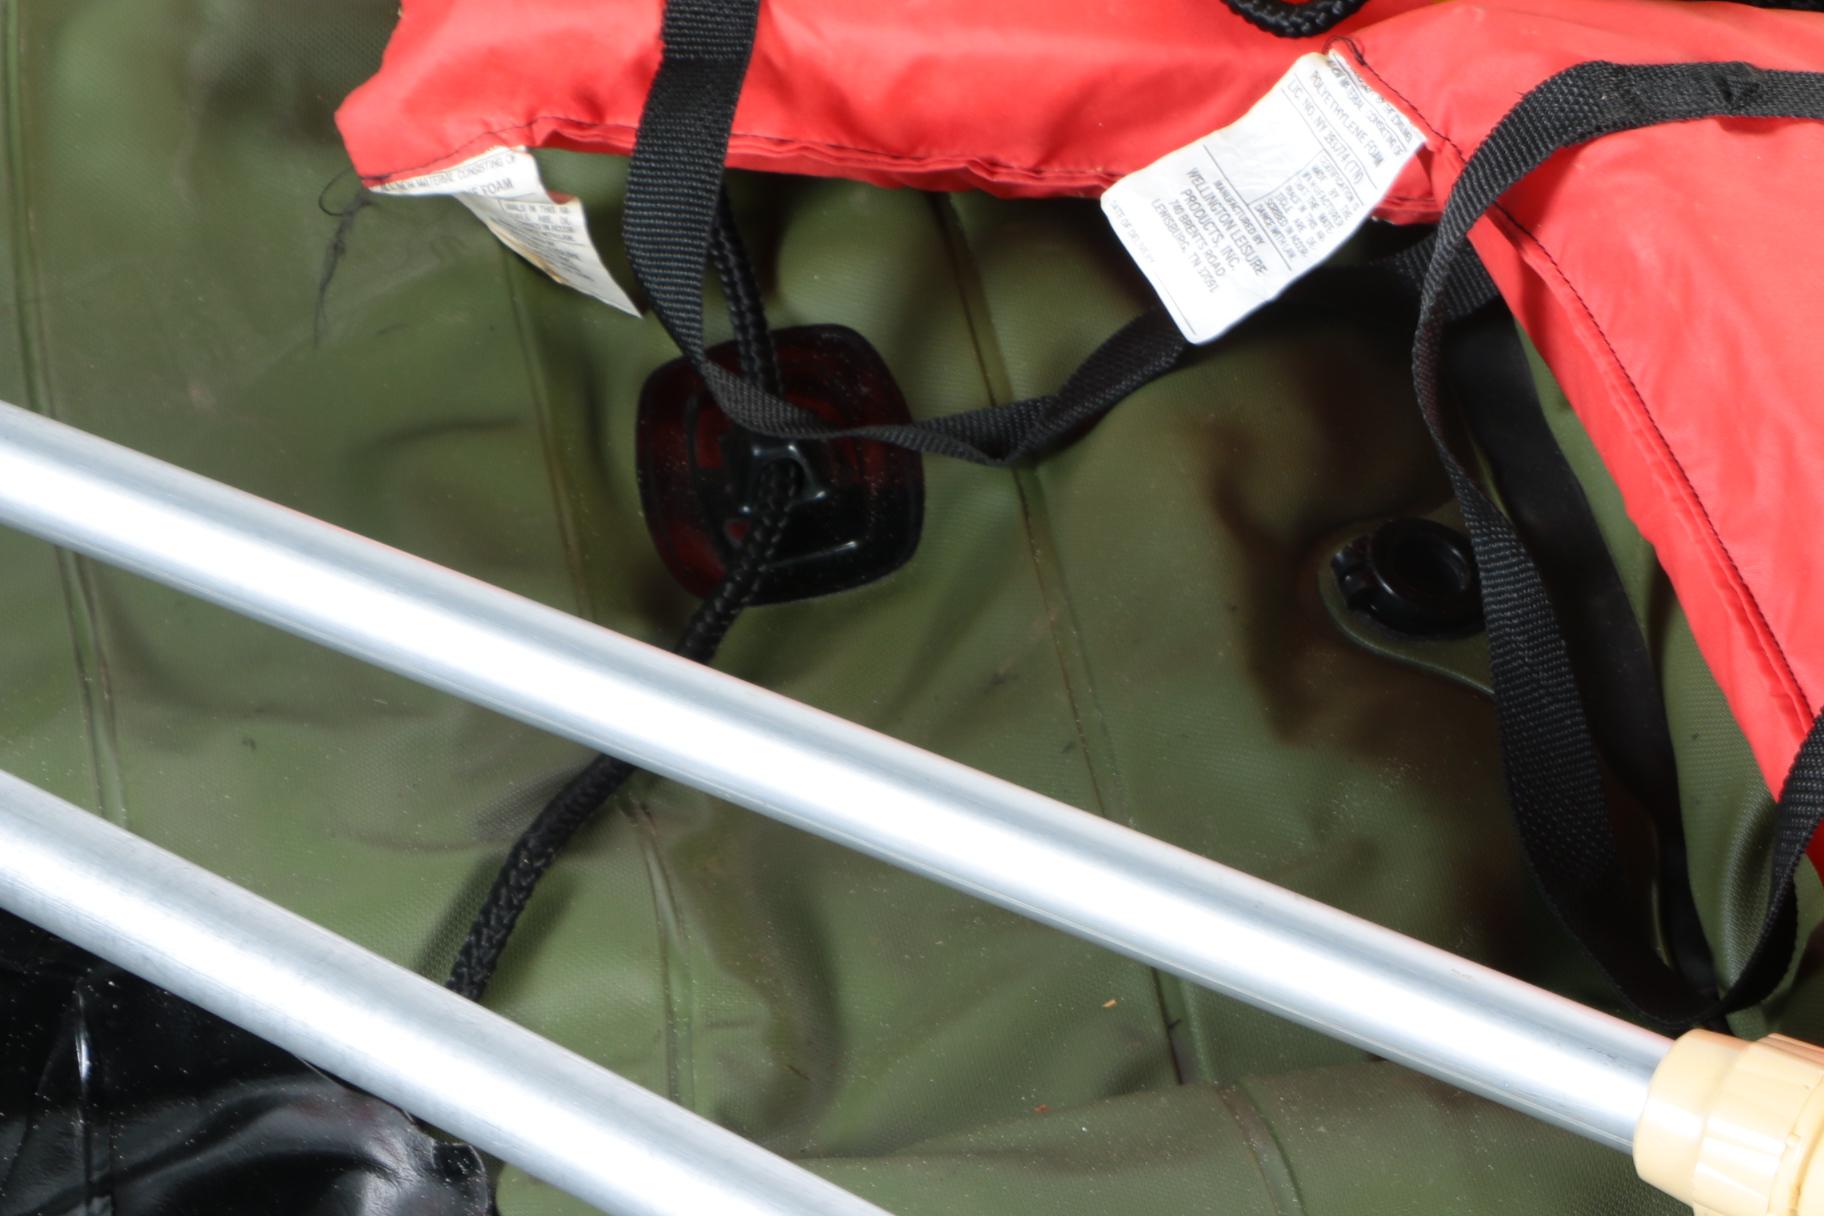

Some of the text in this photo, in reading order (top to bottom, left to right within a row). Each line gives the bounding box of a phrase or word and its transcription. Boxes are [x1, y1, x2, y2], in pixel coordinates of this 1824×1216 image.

[1365, 139, 1385, 167] FOAM
[1177, 211, 1208, 251] BRENTS
[1204, 248, 1226, 278] ROAD
[1186, 167, 1268, 277] WELLINGTON LEISURE
[1213, 179, 1265, 246] MANUFACTURED BY
[1220, 244, 1241, 271] INC.
